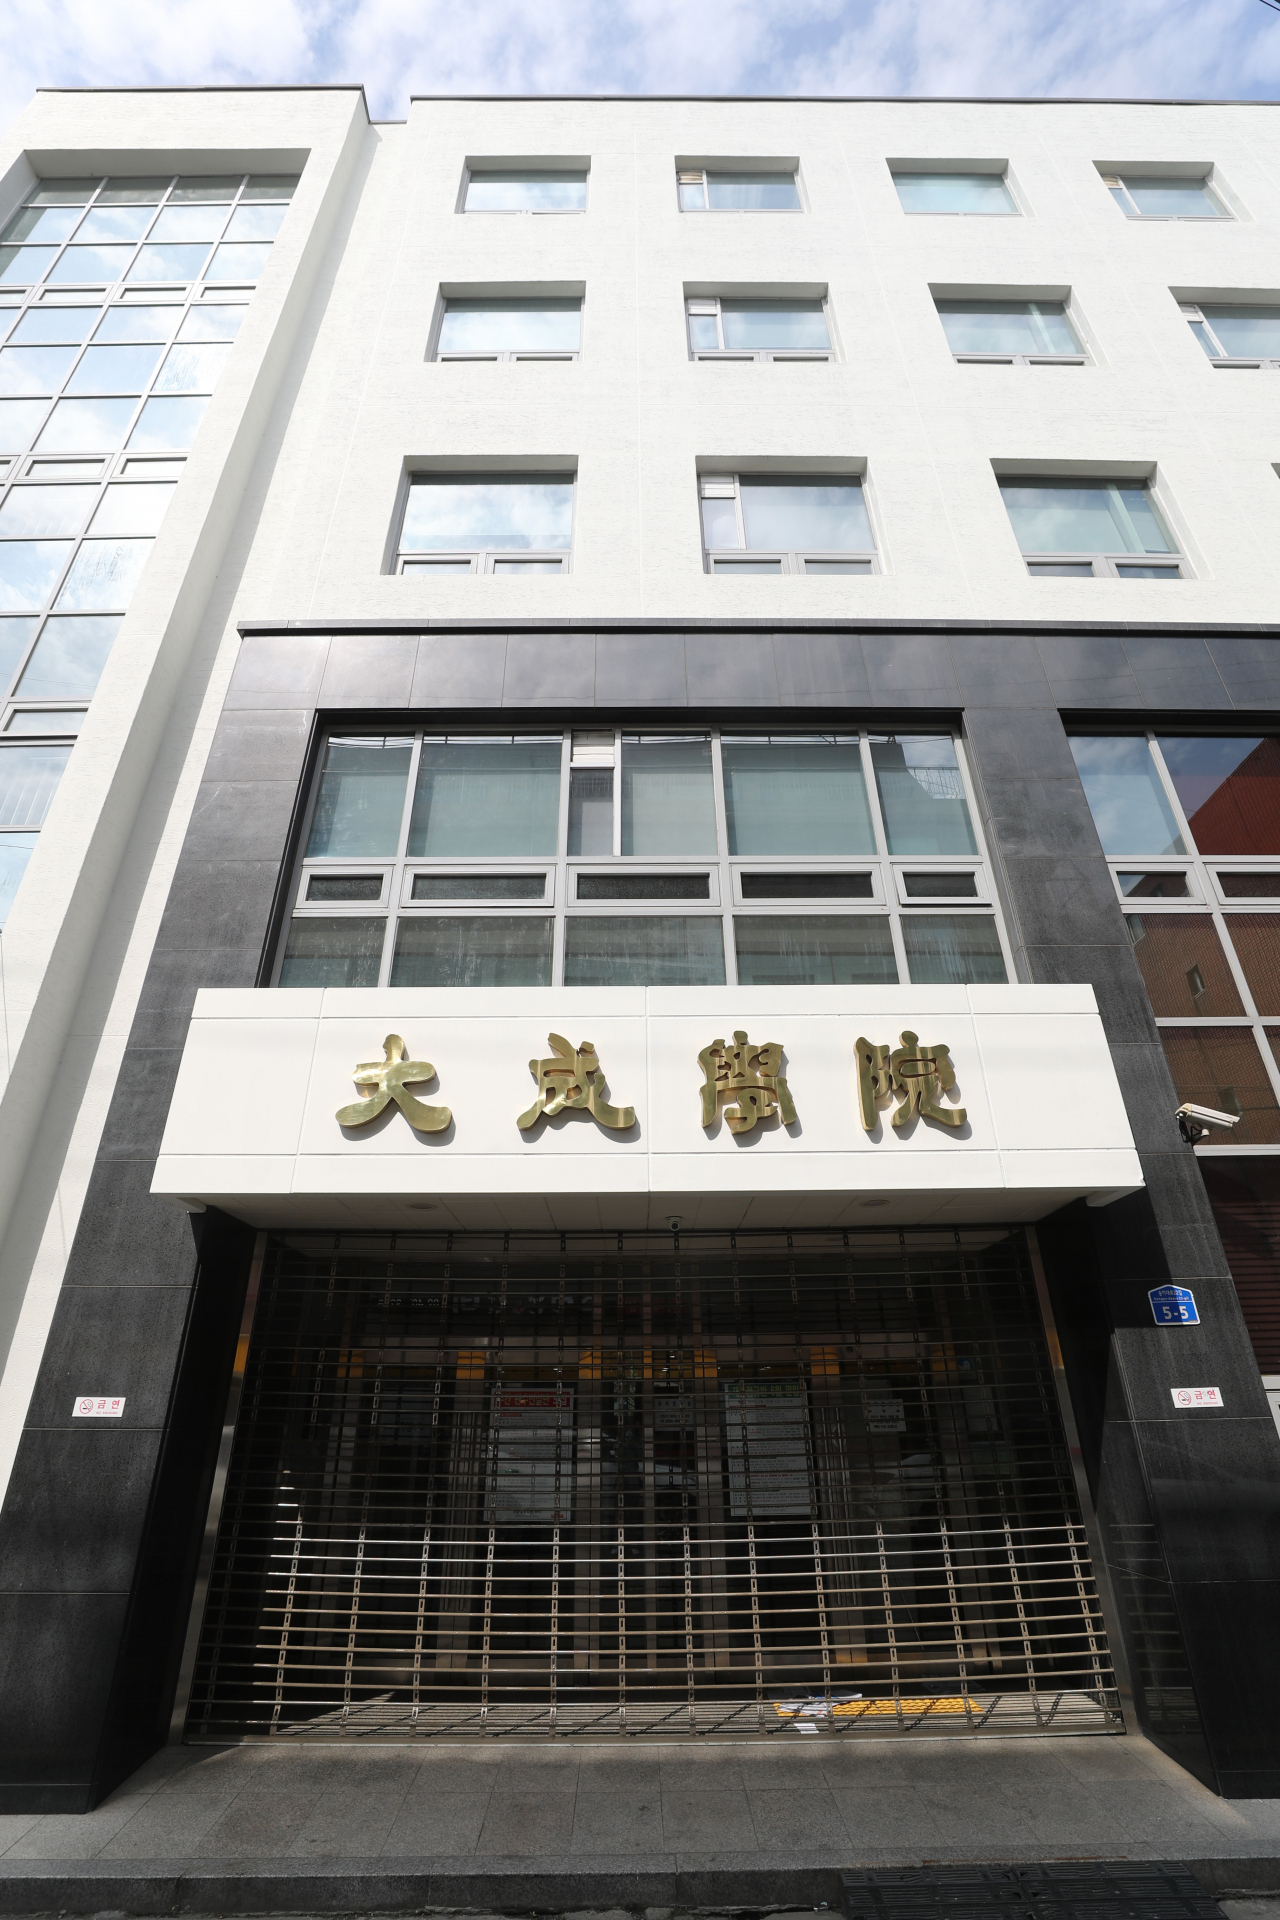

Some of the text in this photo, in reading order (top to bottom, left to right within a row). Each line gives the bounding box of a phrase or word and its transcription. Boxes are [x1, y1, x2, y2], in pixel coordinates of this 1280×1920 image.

[336, 1031, 968, 1136] 大成學院
[1162, 1305, 1189, 1320] 5-5
[1194, 1389, 1216, 1400] 금연
[97, 1399, 120, 1410] 금연
